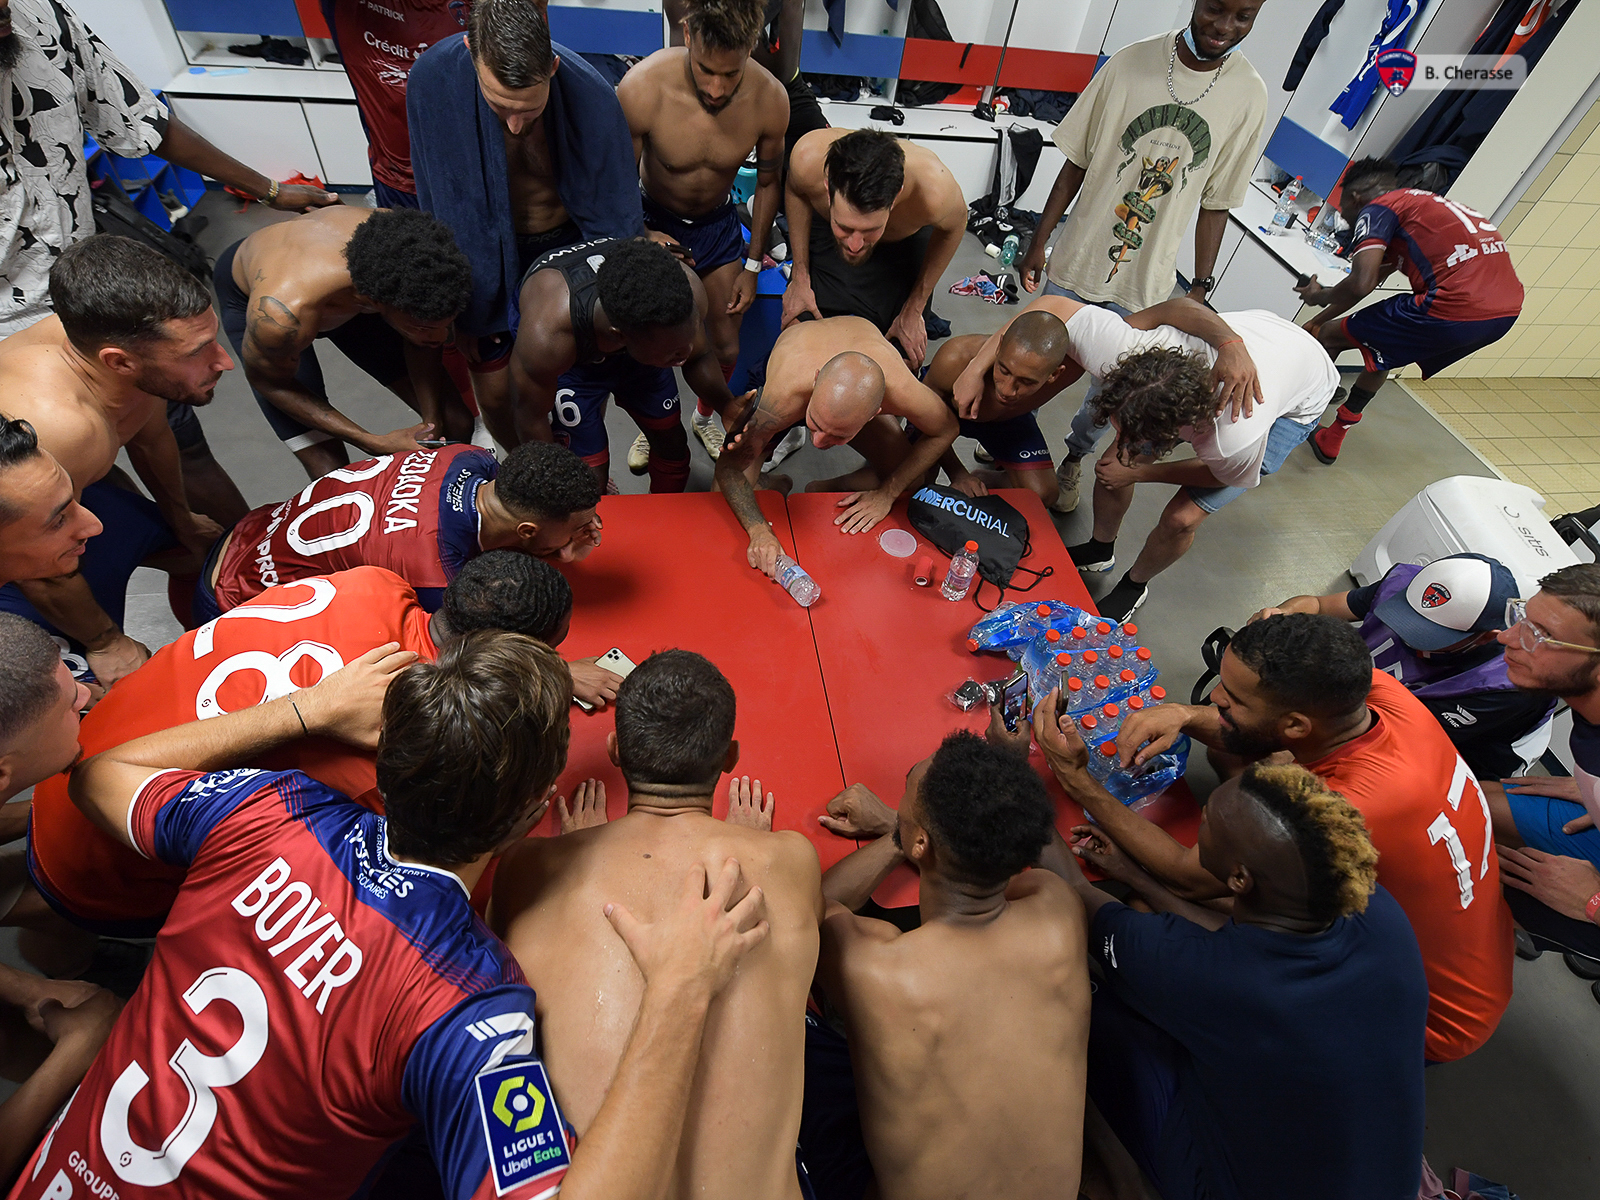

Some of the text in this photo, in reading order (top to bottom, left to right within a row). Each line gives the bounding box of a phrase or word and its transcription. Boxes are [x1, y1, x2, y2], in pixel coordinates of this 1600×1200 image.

[363, 31, 410, 59] Crédit
[367, 2, 405, 22] PATRICK
[286, 454, 395, 557] 20
[384, 450, 438, 534] ZEDADKA
[912, 487, 1010, 538] MERCURIAL
[186, 578, 344, 721] 28
[1426, 752, 1493, 910] 17
[355, 872, 389, 900] SOLAIRES
[231, 856, 363, 1015] BOYER
[100, 966, 269, 1188] 3
[502, 1146, 562, 1177] Uber Eats
[503, 1130, 554, 1159] LIGUE 1
